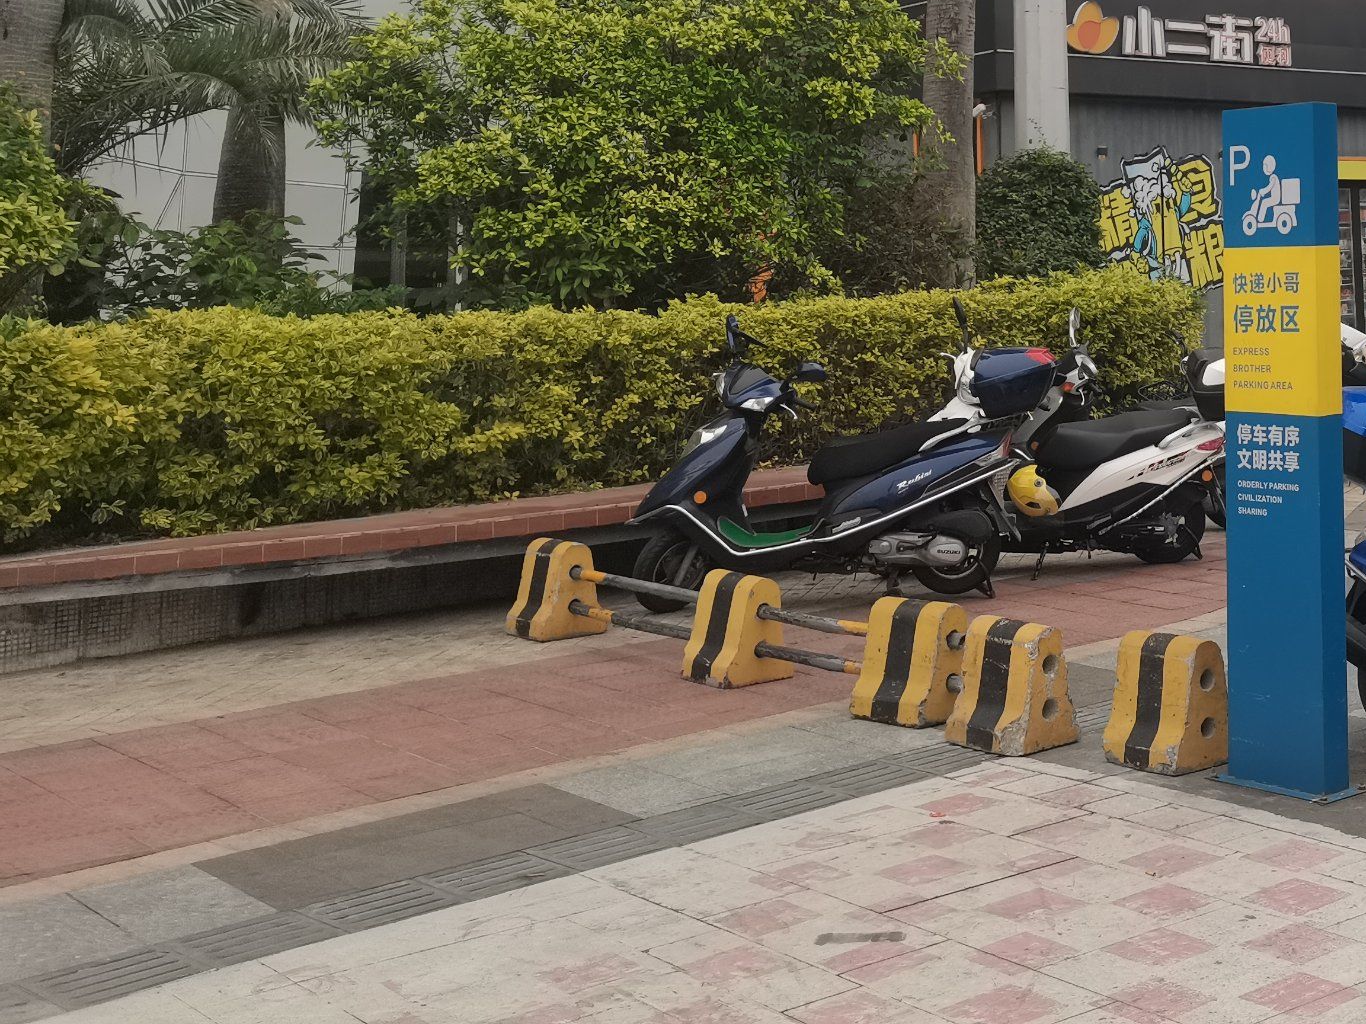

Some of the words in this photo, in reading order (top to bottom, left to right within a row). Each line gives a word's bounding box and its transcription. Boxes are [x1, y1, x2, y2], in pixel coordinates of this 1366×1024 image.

[1121, 6, 1254, 64] 小二街
[1254, 16, 1292, 44] 24h
[1229, 144, 1251, 187] P
[1232, 272, 1300, 295] 快递小哥
[1233, 304, 1300, 334] 停放区
[1232, 346, 1270, 357] EXPRESS
[1232, 363, 1272, 374] BROTHER
[1233, 380, 1269, 390] PARKING
[1270, 381, 1294, 391] AREA
[1236, 423, 1300, 447] 停车有序
[1236, 448, 1300, 473] 文明共享
[1237, 479, 1269, 490] ORDERLY
[1269, 482, 1300, 492] PARKING
[1237, 493, 1284, 504] CIVILIZATION
[1237, 506, 1268, 517] SHARING
